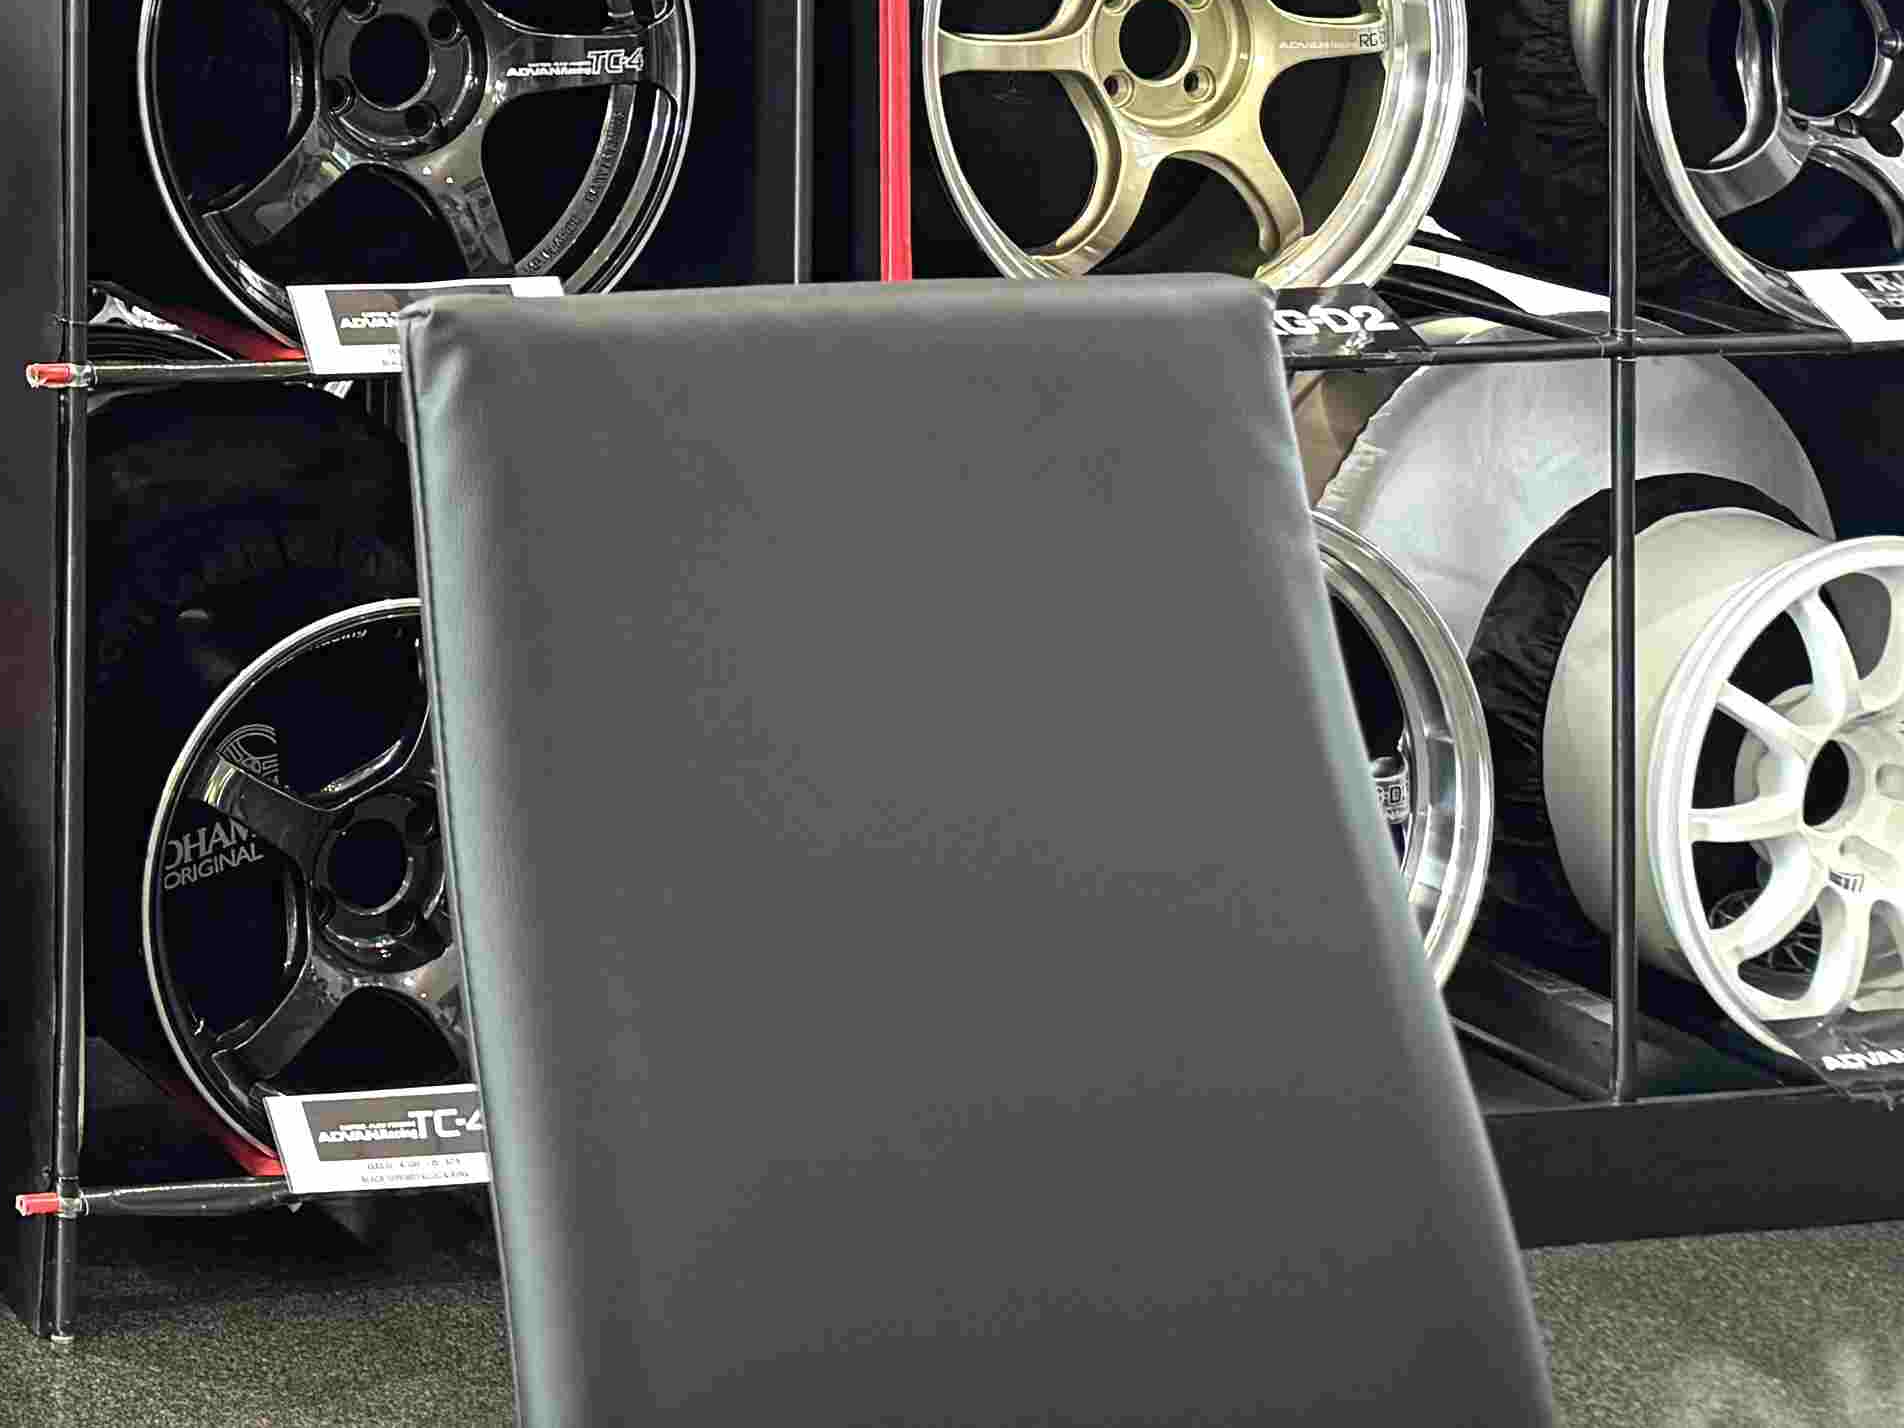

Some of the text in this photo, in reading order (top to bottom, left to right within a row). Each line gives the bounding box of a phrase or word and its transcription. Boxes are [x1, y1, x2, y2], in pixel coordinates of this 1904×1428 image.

[587, 46, 644, 74] TC-4
[1273, 304, 1400, 337] G-D2
[163, 843, 264, 889] ORIGINAL
[318, 1129, 380, 1142] ADVAN
